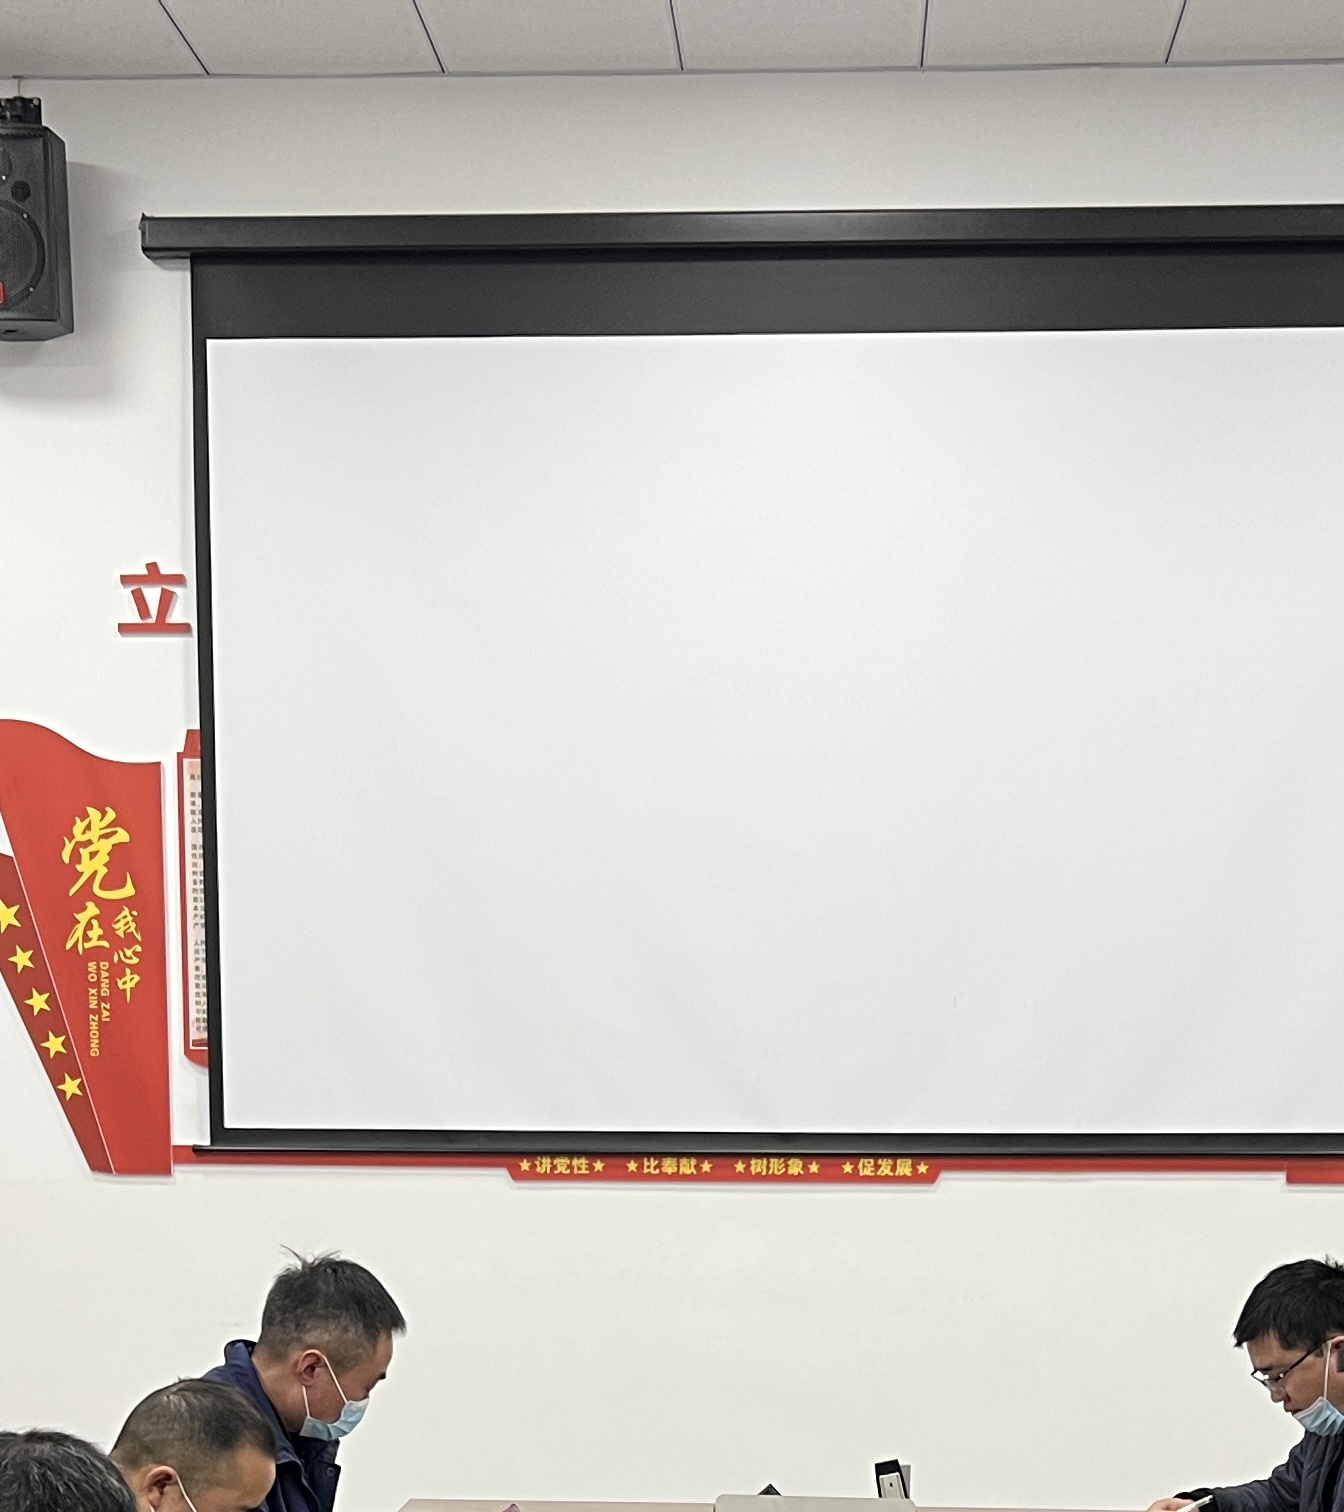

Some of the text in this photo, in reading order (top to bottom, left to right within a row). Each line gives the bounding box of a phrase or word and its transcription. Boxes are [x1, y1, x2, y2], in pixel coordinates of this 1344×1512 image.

[87, 961, 100, 1057] WO XIN ZHONG
[99, 961, 111, 1022] DANG ZAI
[534, 1156, 913, 1176] 讲党性 比奉献 树形象 促发展
